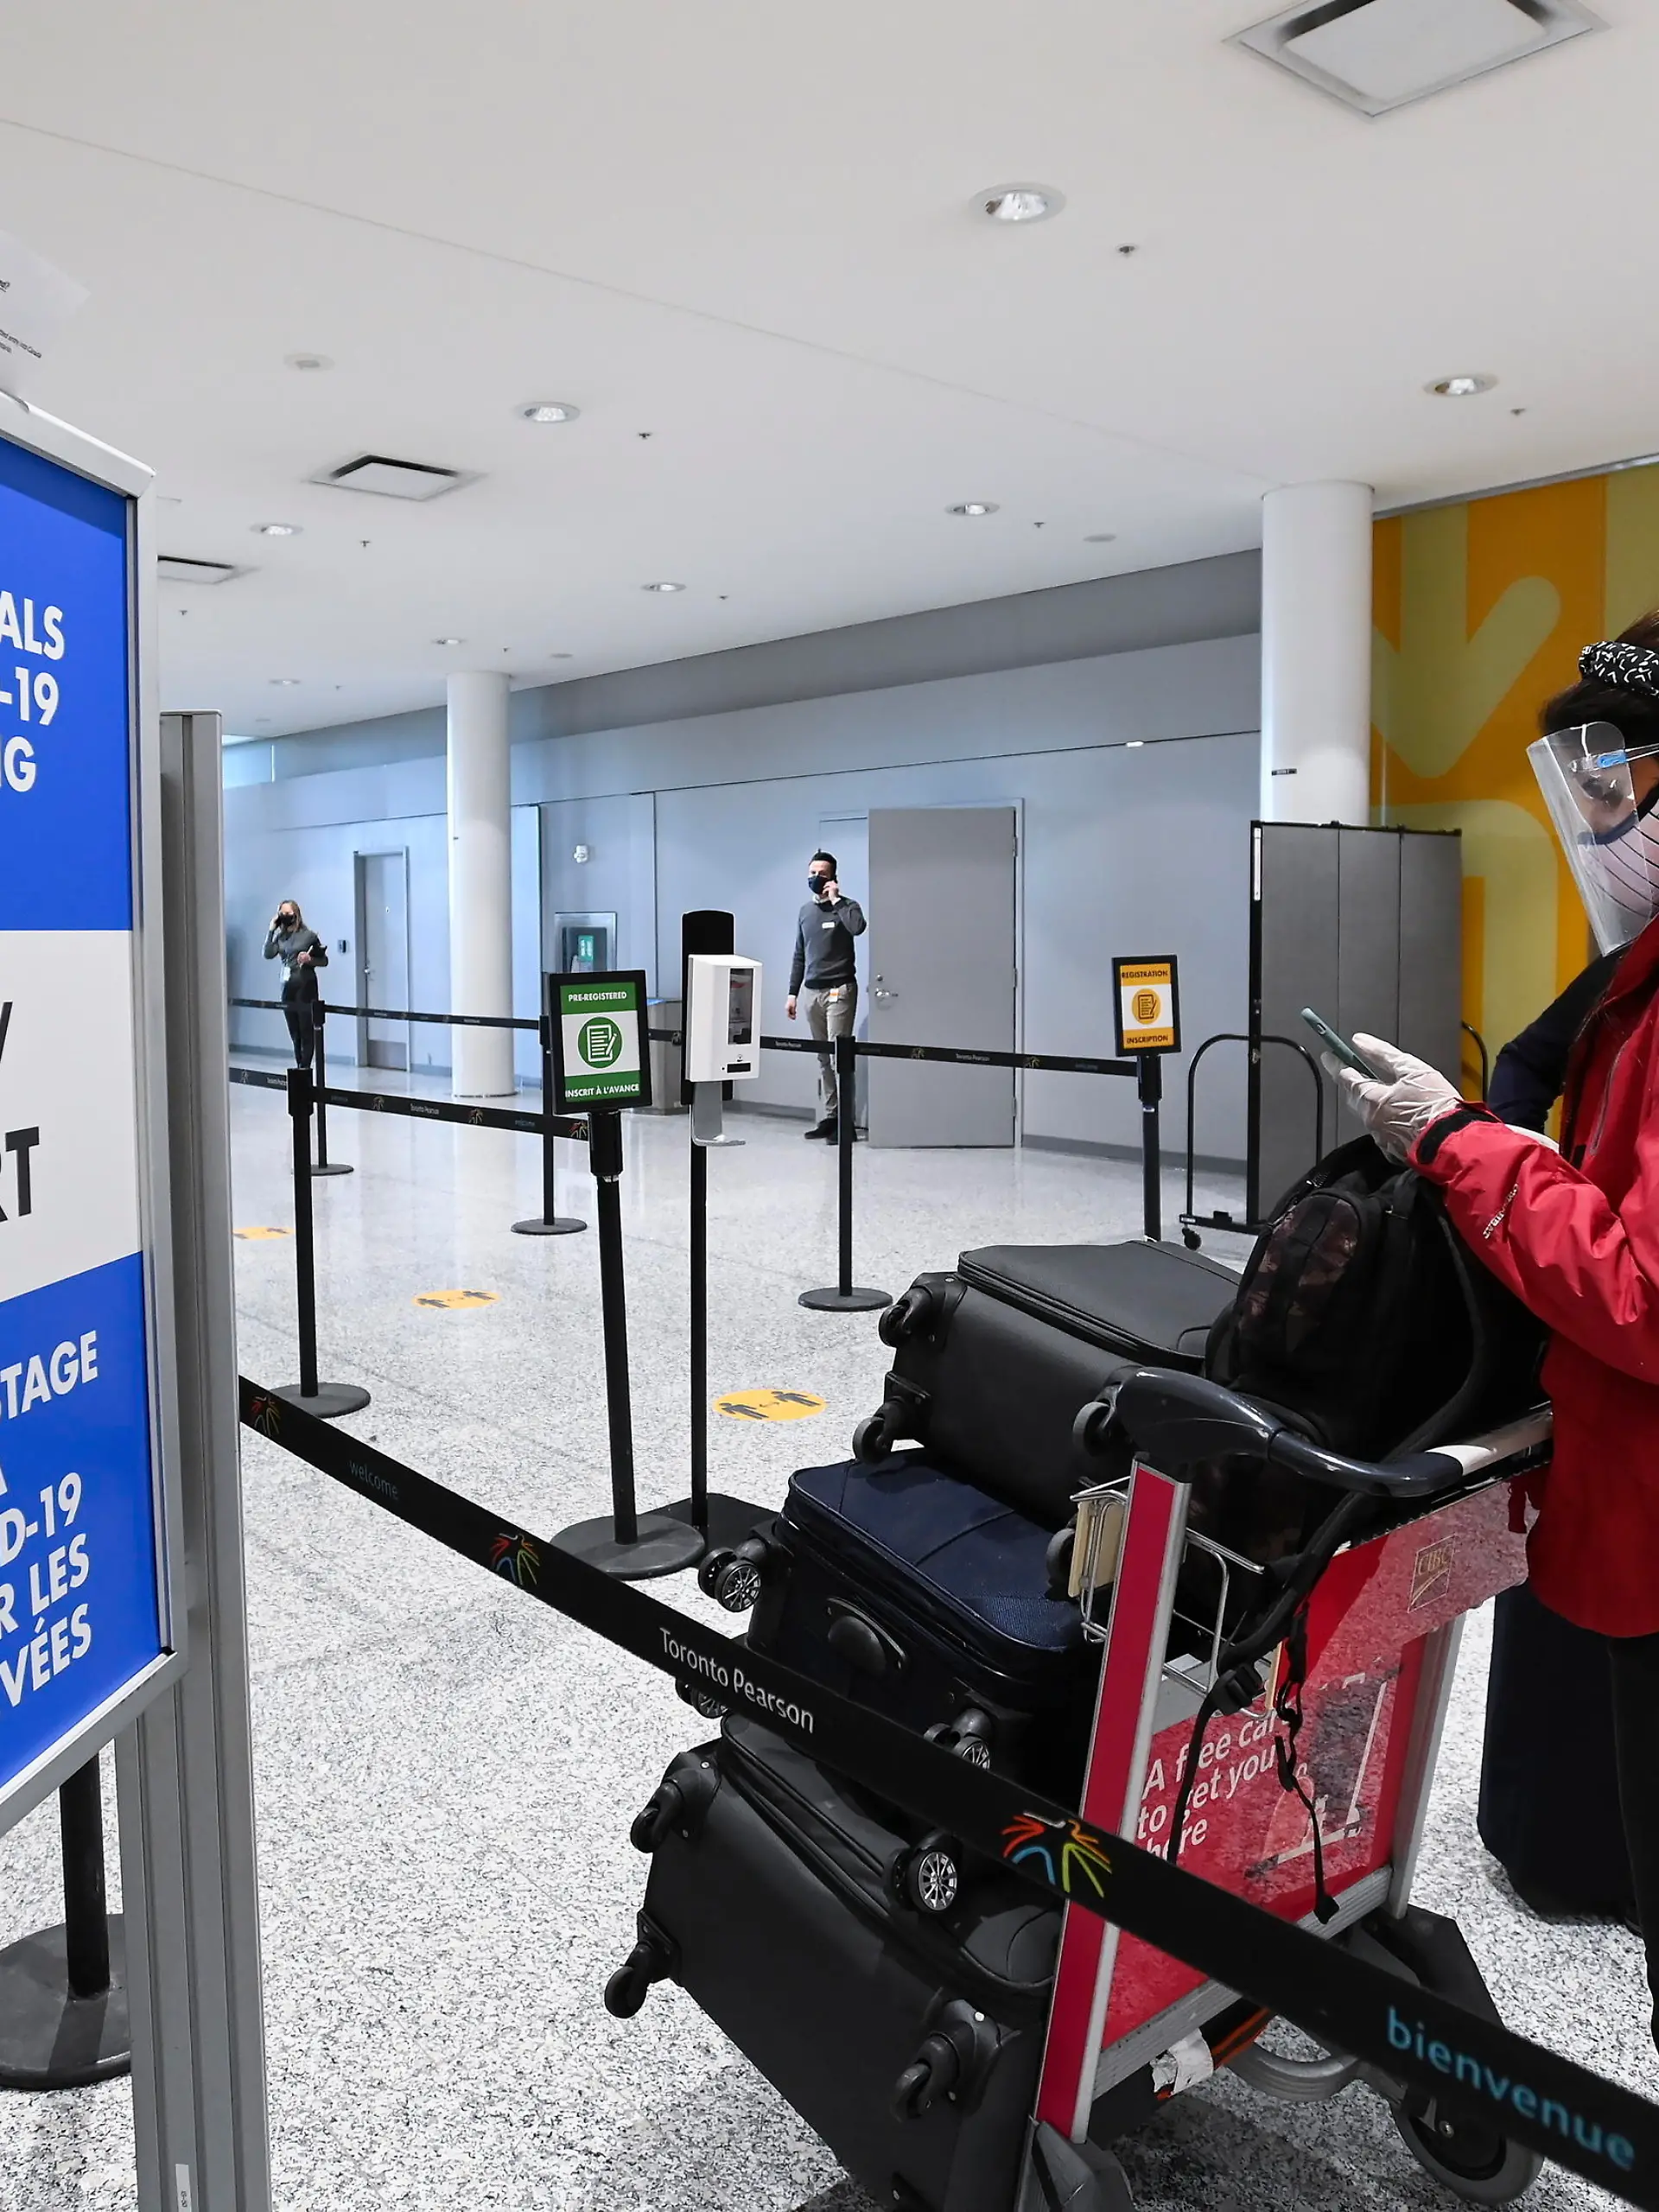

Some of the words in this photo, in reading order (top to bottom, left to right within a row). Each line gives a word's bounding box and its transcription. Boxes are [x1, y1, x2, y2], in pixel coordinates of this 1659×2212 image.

[0, 590, 65, 661] ALS
[0, 735, 36, 792] G
[568, 991, 627, 1002] PRE-REGISTERED
[1122, 969, 1169, 979] REGISTRATION
[1127, 1034, 1169, 1045] INSCRIPTION
[565, 1086, 594, 1098] INSCRIT
[595, 1084, 602, 1096] À
[603, 1083, 639, 1095] L'AVANCE
[0, 1126, 40, 1223] T
[0, 1330, 99, 1420] TAGE
[346, 1460, 399, 1501] welcome
[29, 1533, 90, 1617] LES
[0, 1603, 92, 1707] VÉES
[659, 1627, 729, 1688] Toronto
[734, 1668, 814, 1734] Pearson
[1141, 1758, 1166, 1800] A
[1176, 1733, 1231, 1783] fee
[1238, 1700, 1291, 1748] car
[1137, 1804, 1167, 1840] to
[1183, 1770, 1224, 1825] et
[1217, 1744, 1277, 1799] you
[1147, 1819, 1208, 1861] hre
[1386, 2005, 1636, 2172] bienvenue
